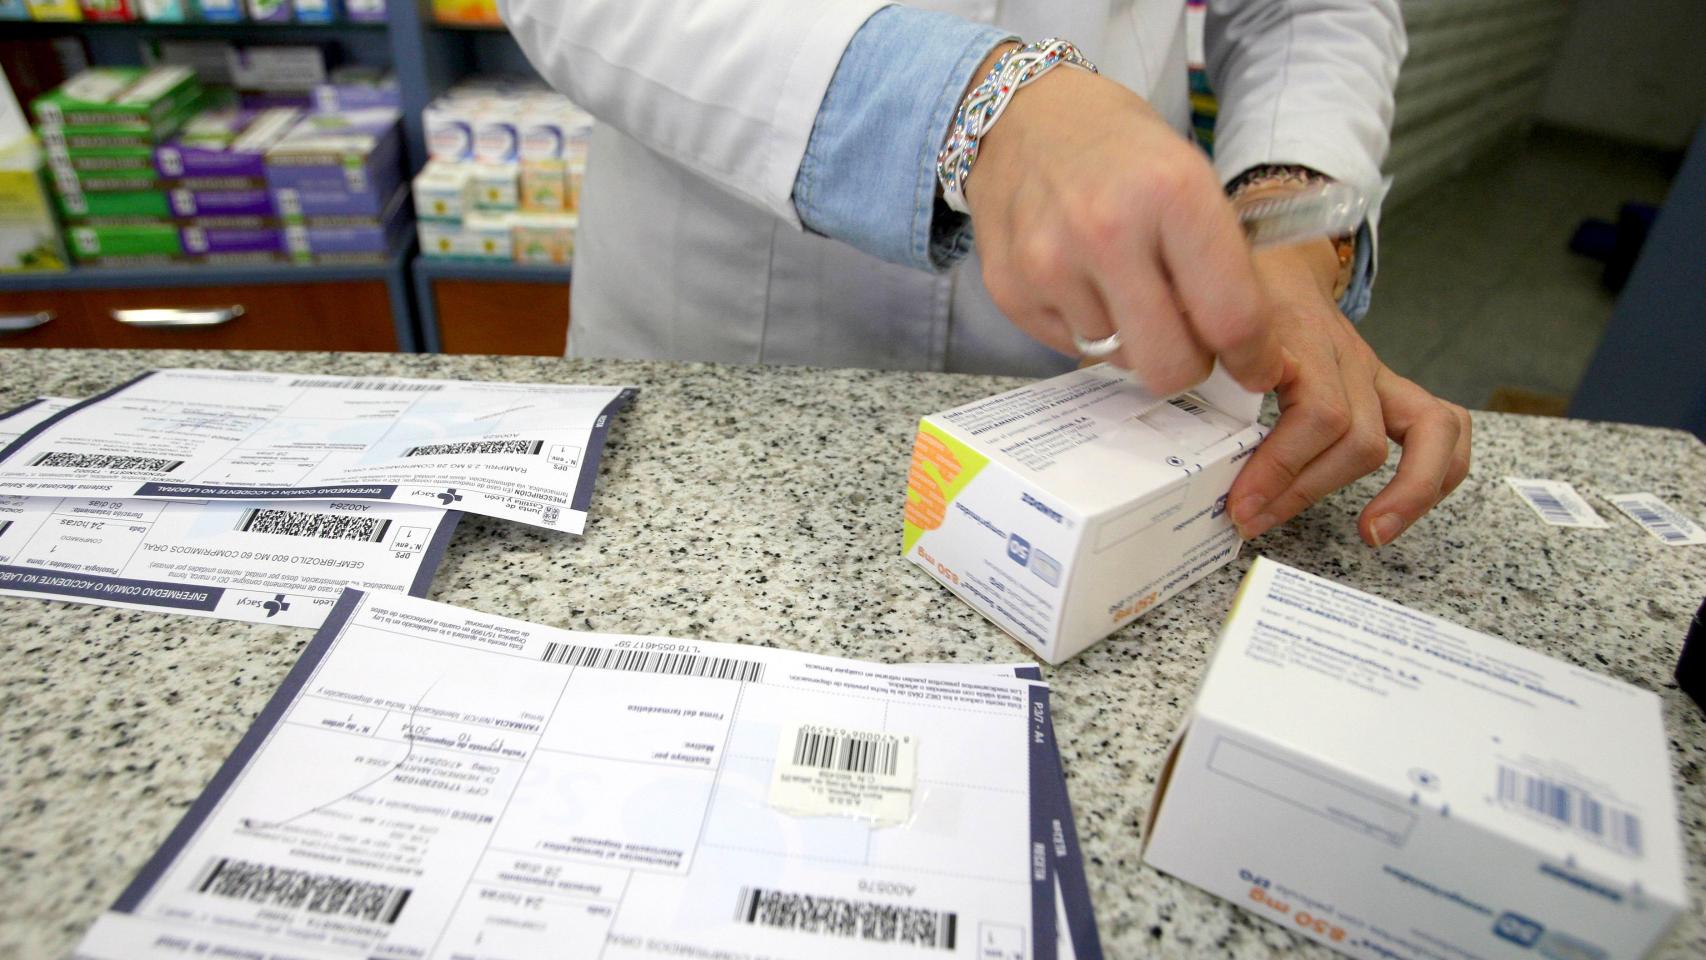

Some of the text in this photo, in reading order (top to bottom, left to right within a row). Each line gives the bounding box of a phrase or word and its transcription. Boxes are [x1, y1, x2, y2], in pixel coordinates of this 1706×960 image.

[410, 488, 436, 498] Sacyl
[328, 501, 371, 511] A00264
[58, 518, 90, 528] horas
[140, 542, 169, 551] ORAL
[168, 544, 240, 558] COMPRIMIDOS
[270, 554, 290, 562] 600
[289, 555, 366, 568] GEMFIBROZILO
[37, 575, 95, 589] ACCIDENTE
[101, 582, 143, 595] COMÚN
[140, 587, 209, 601] ENFERMEDAD
[235, 597, 263, 607] Sacyl
[310, 598, 335, 606] León
[371, 613, 385, 621] Ley
[632, 640, 676, 651] 0554617
[1295, 911, 1347, 943] 850
